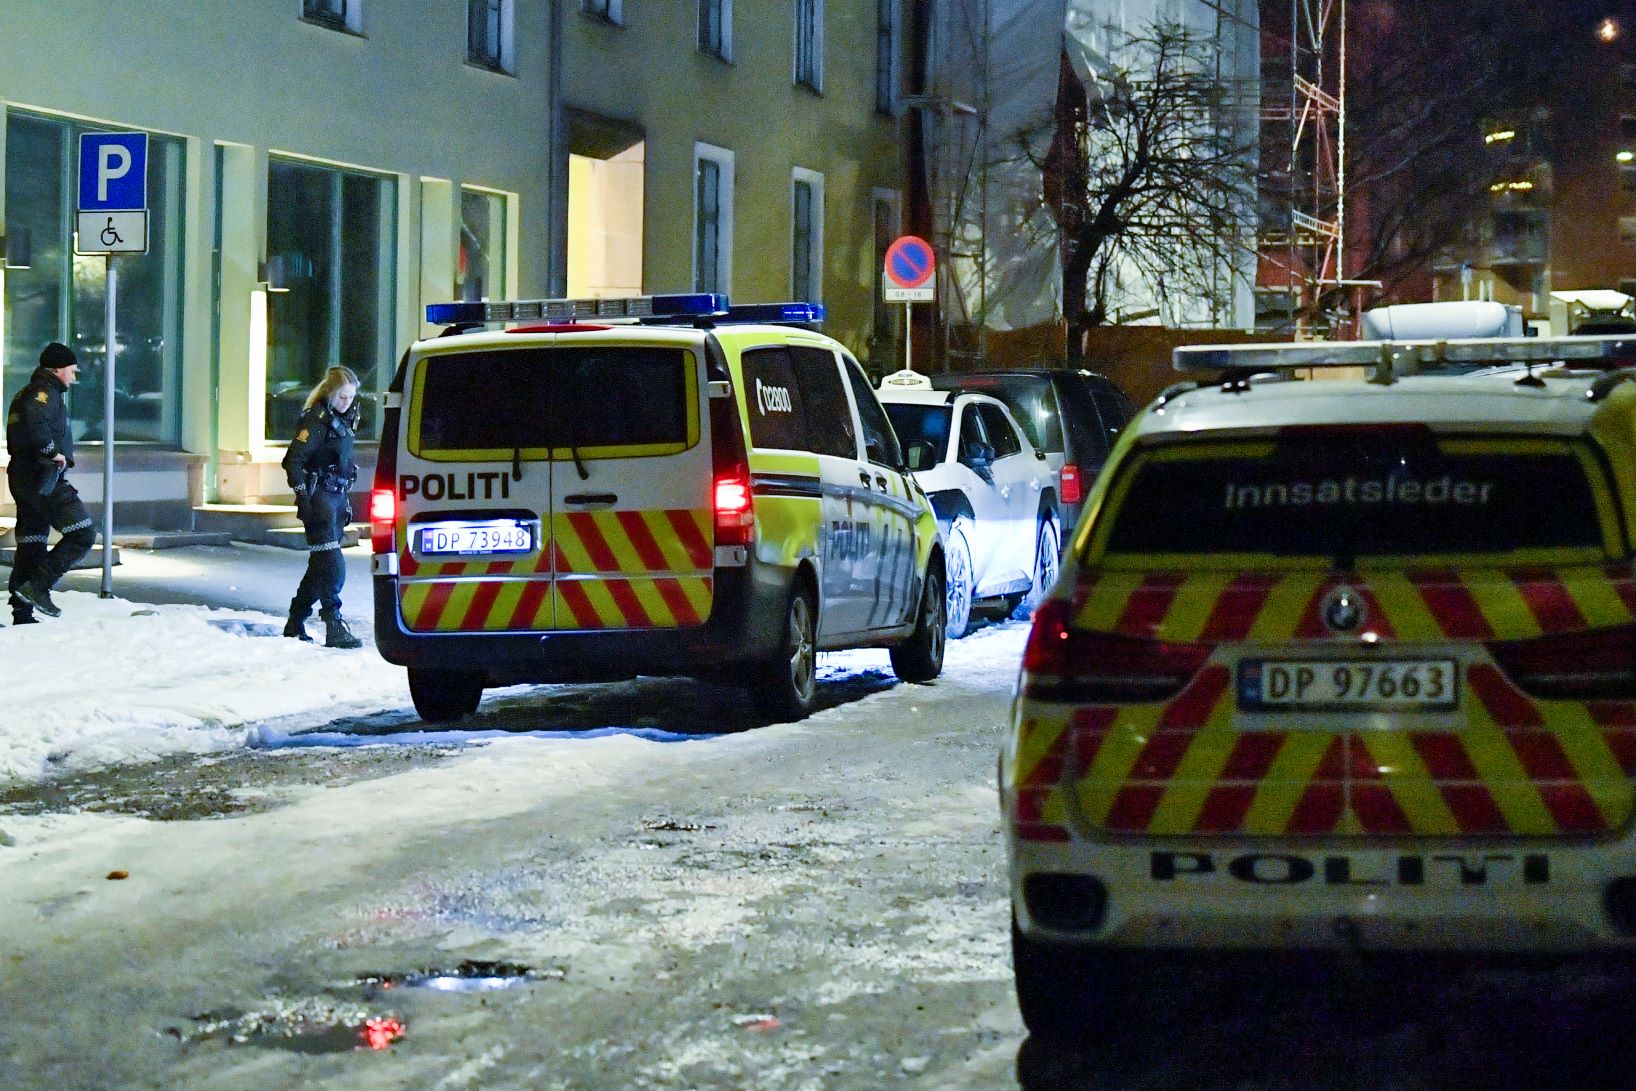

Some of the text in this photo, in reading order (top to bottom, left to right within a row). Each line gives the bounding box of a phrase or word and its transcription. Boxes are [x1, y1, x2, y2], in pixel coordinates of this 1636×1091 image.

[97, 144, 132, 201] P
[762, 385, 792, 413] 02800
[399, 472, 509, 501] POLITI
[1224, 473, 1495, 509] Innsatsleder
[437, 530, 525, 550] DP 73948
[1269, 666, 1444, 698] DP 97663
[1150, 851, 1550, 885] POLITI
